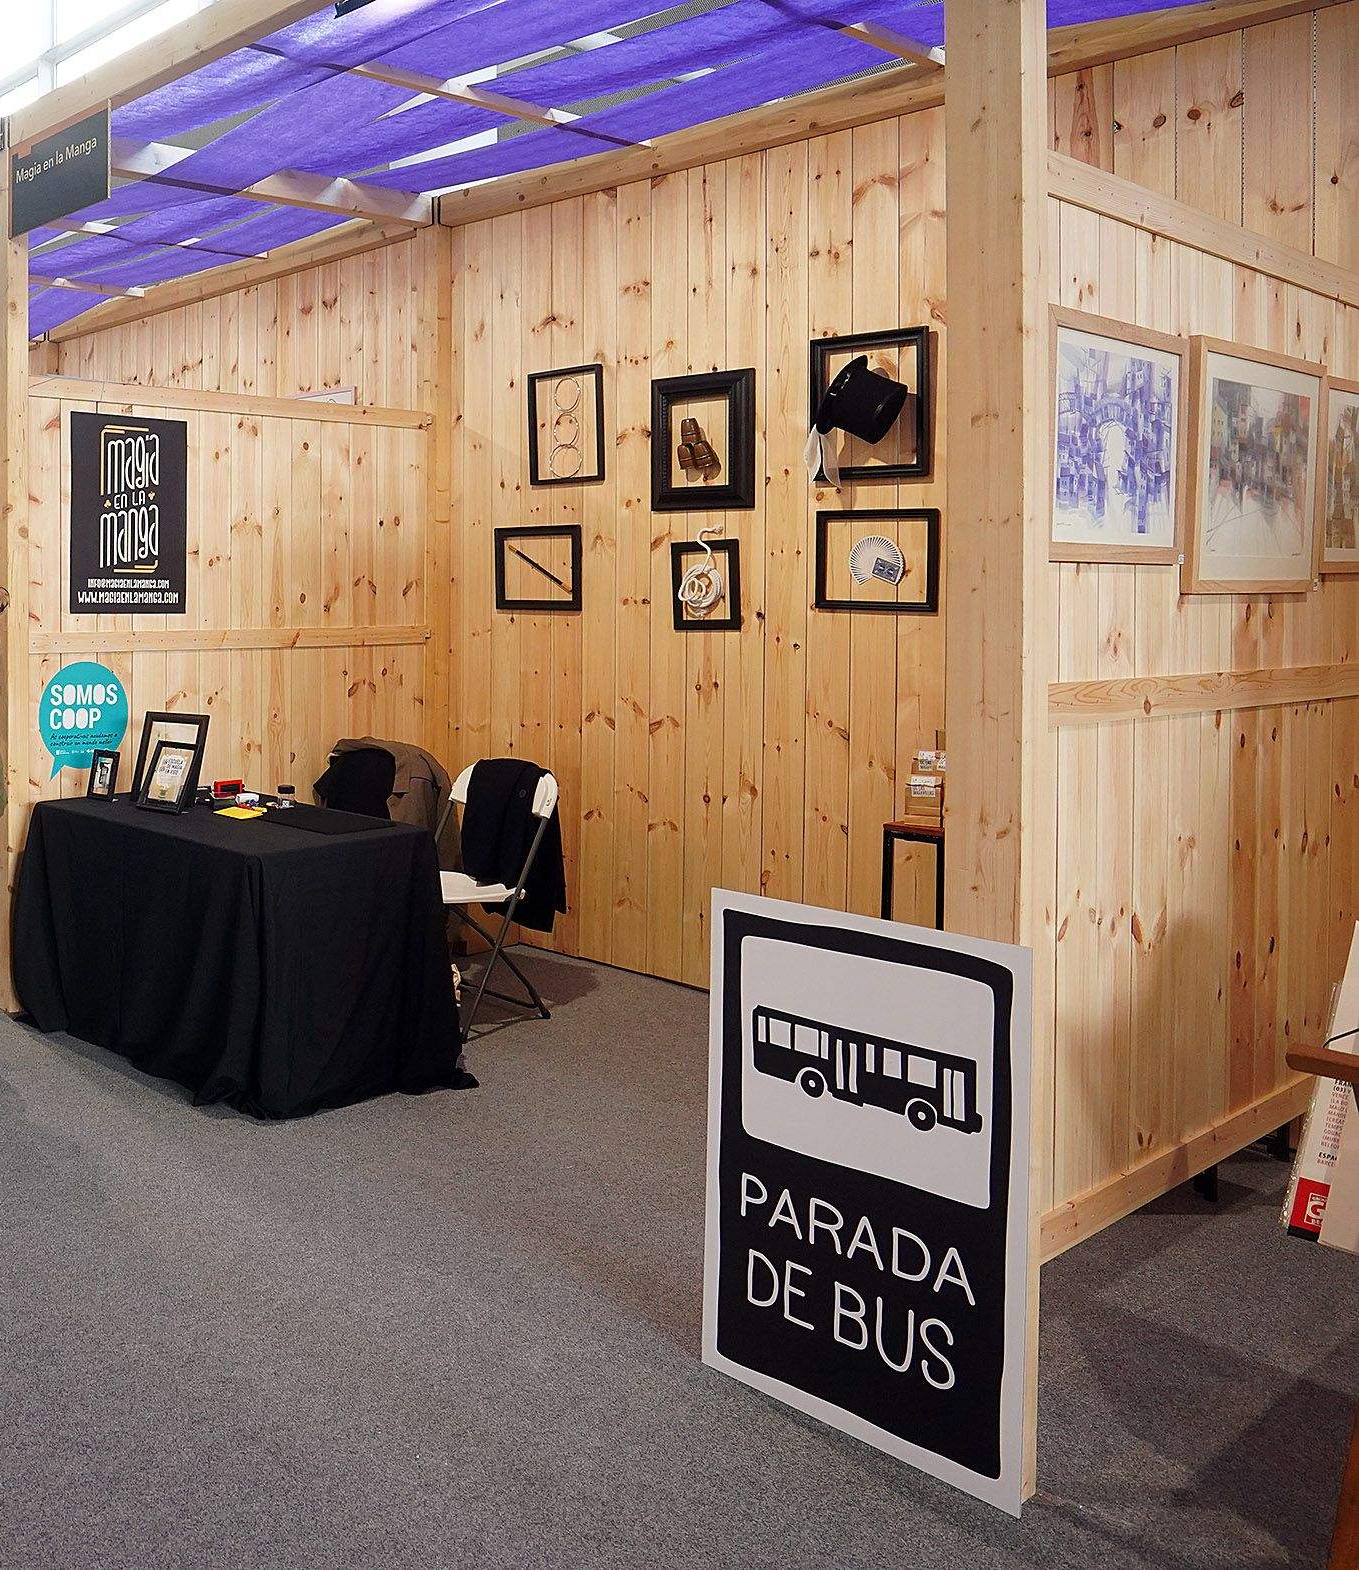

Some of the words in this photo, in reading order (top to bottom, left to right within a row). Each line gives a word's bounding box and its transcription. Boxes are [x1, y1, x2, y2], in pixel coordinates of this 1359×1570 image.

[16, 162, 41, 183] Magia
[43, 158, 54, 171] en
[56, 150, 63, 165] la
[66, 137, 97, 161] Manga
[107, 433, 160, 495] magia
[113, 493, 128, 509] EN
[132, 490, 146, 506] LA
[99, 504, 160, 568] manga
[49, 708, 102, 730] COOP
[50, 684, 119, 706] SOMOS
[740, 1173, 977, 1306] PARADA
[747, 1248, 815, 1331] DE
[834, 1281, 956, 1390] BUS
